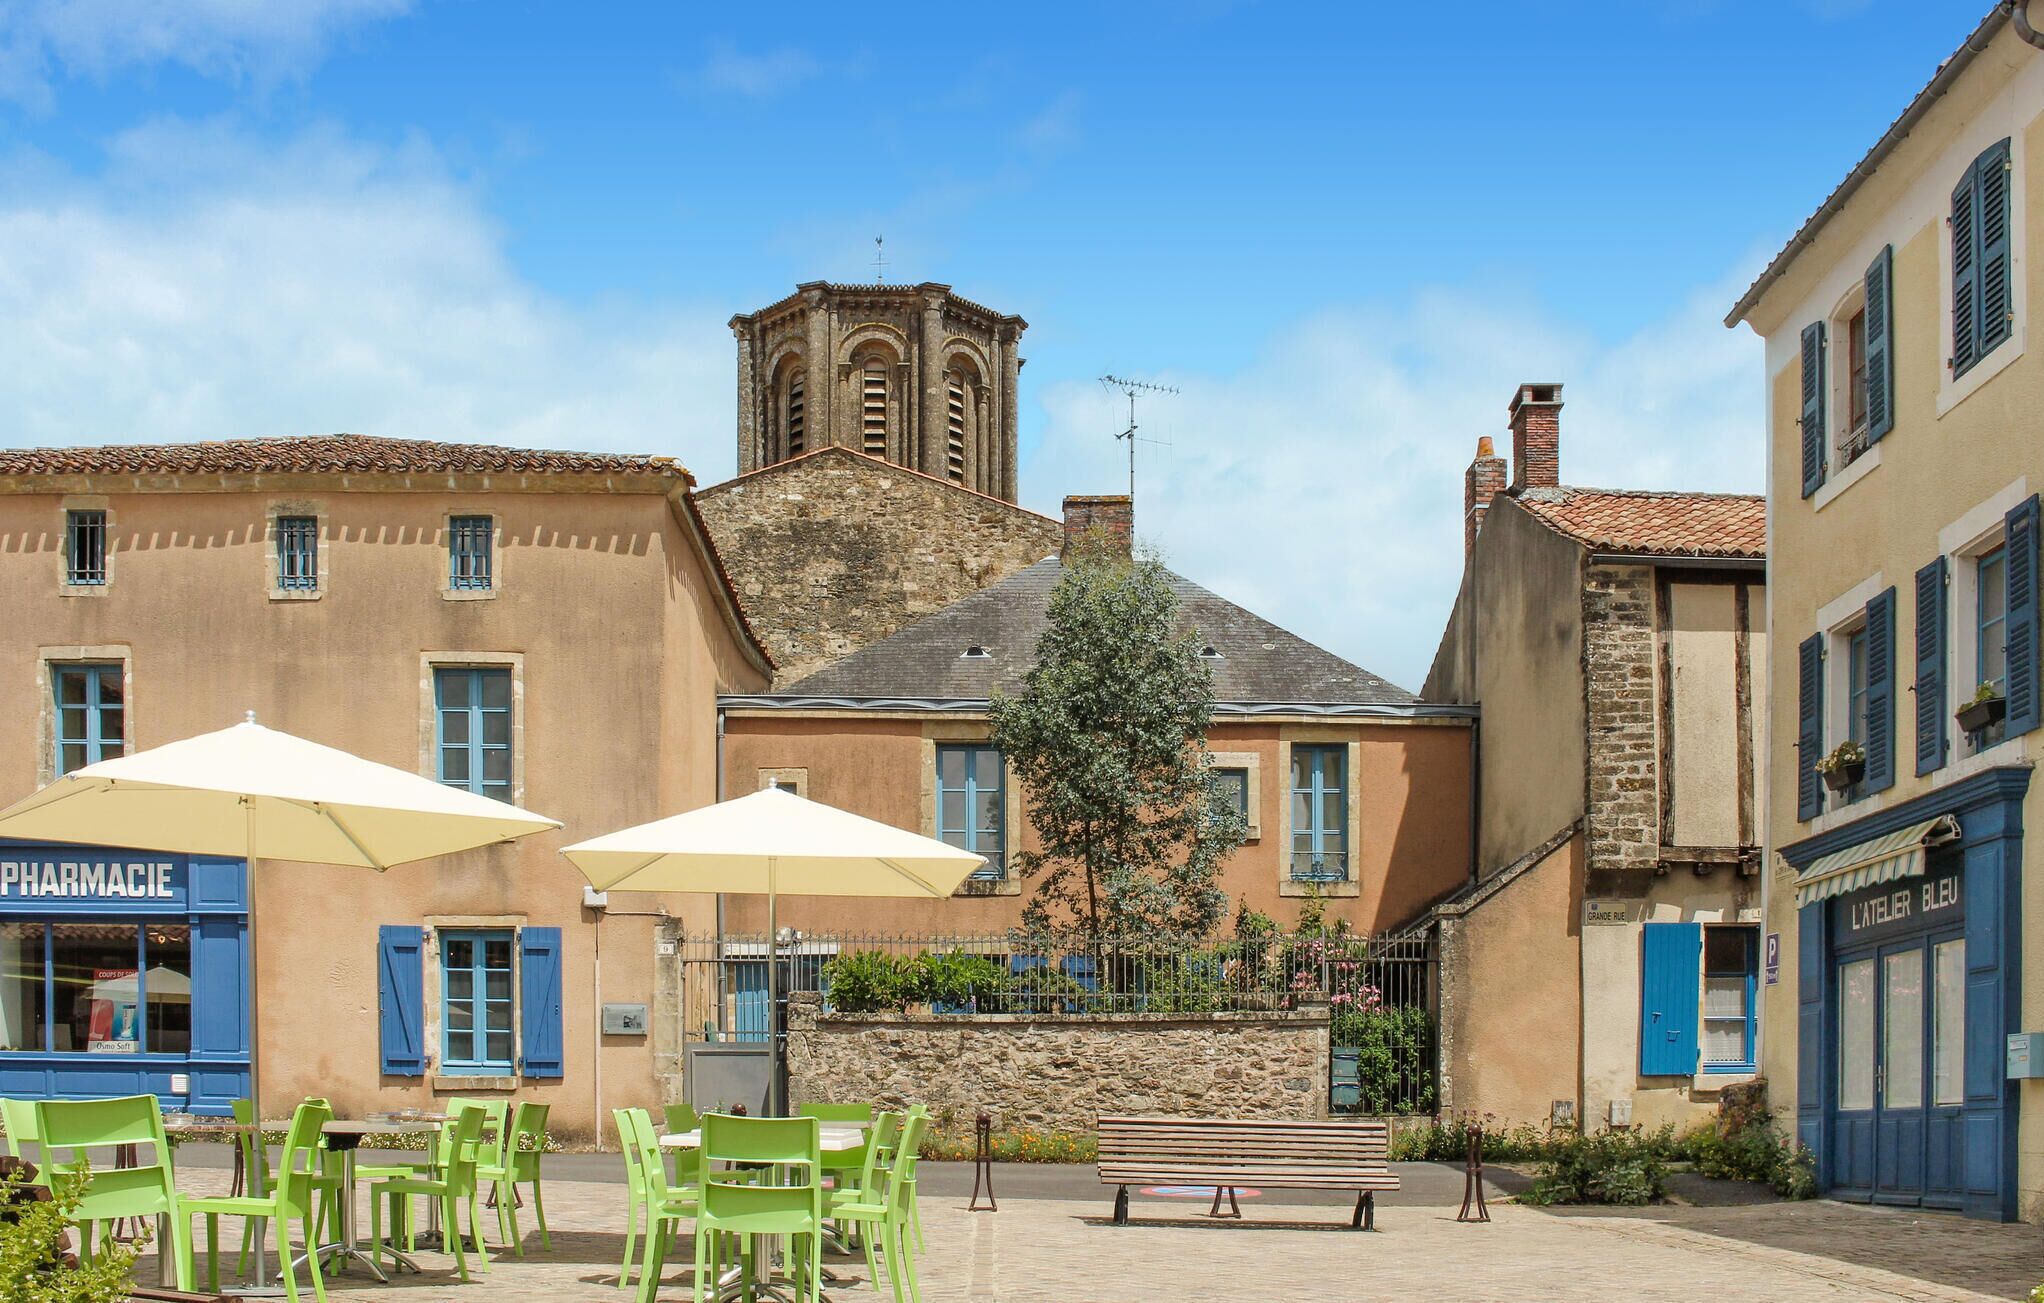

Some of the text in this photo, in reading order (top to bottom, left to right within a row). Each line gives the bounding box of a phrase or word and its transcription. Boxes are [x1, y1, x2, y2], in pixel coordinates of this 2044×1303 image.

[0, 862, 173, 898] PHARMACIE
[1588, 911, 1625, 920] GRANDE RUE
[1852, 875, 1958, 930] L'ATELIER BLEU
[1768, 938, 1776, 964] P
[116, 1042, 130, 1050] Soft
